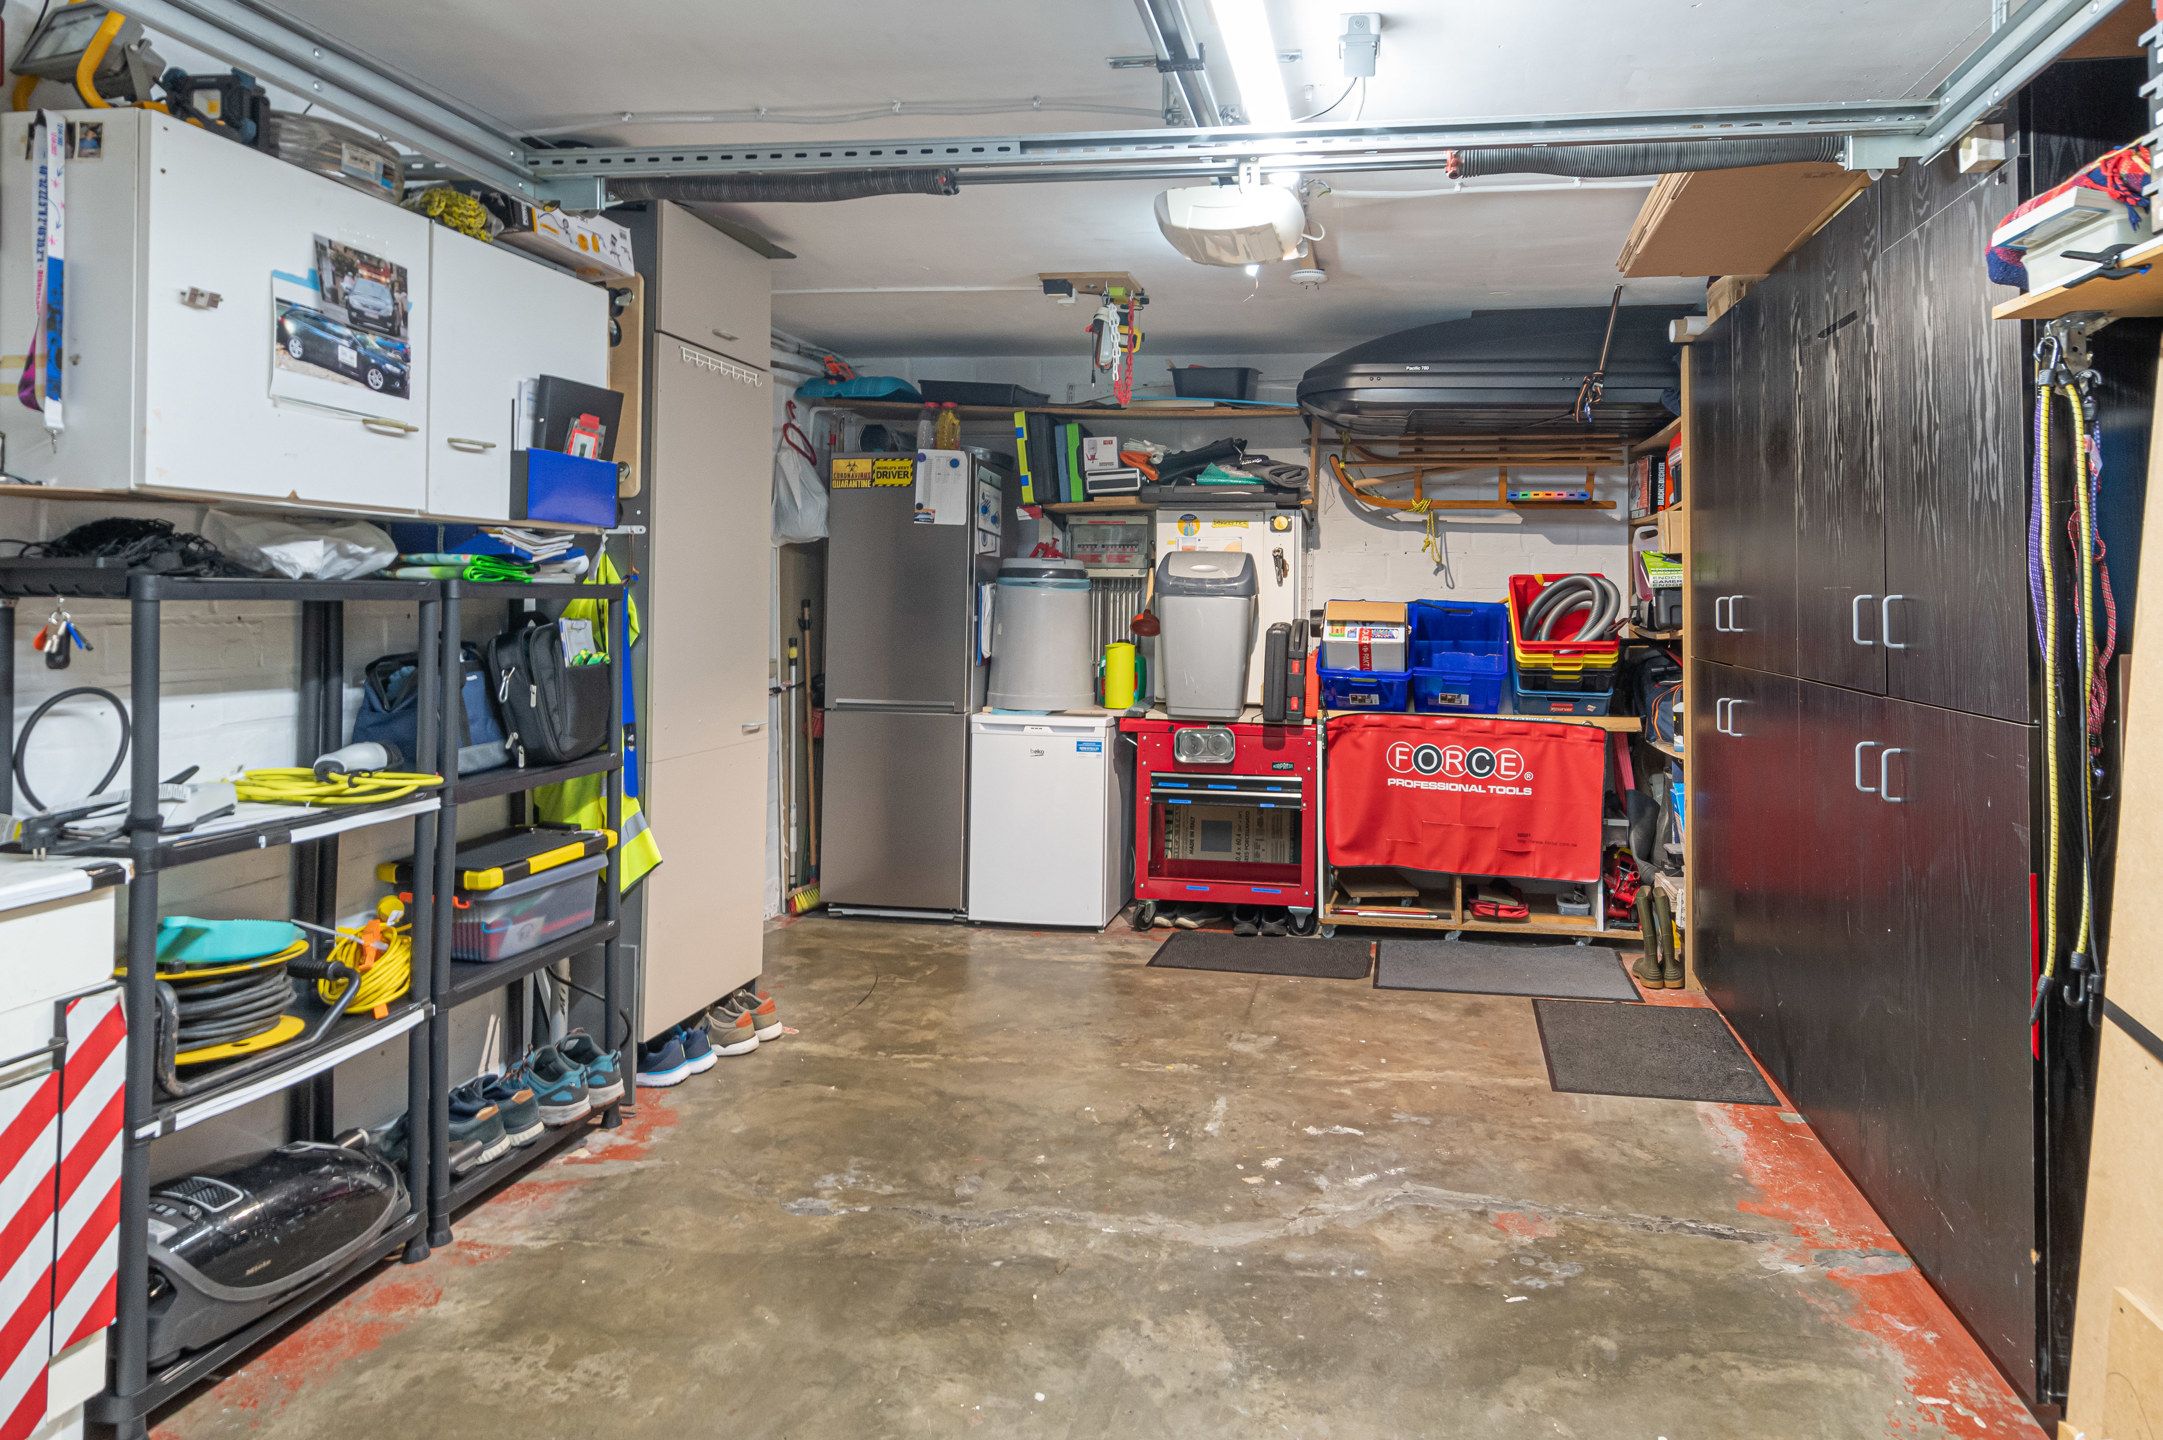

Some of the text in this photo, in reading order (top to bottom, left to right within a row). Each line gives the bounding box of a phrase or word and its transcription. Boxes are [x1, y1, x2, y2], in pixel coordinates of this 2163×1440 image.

[876, 470, 909, 479] DRIVER
[832, 480, 871, 488] QUARANTINE
[1394, 746, 1518, 777] FORCE
[1387, 777, 1533, 796] PROFESSIONAL TOOLS
